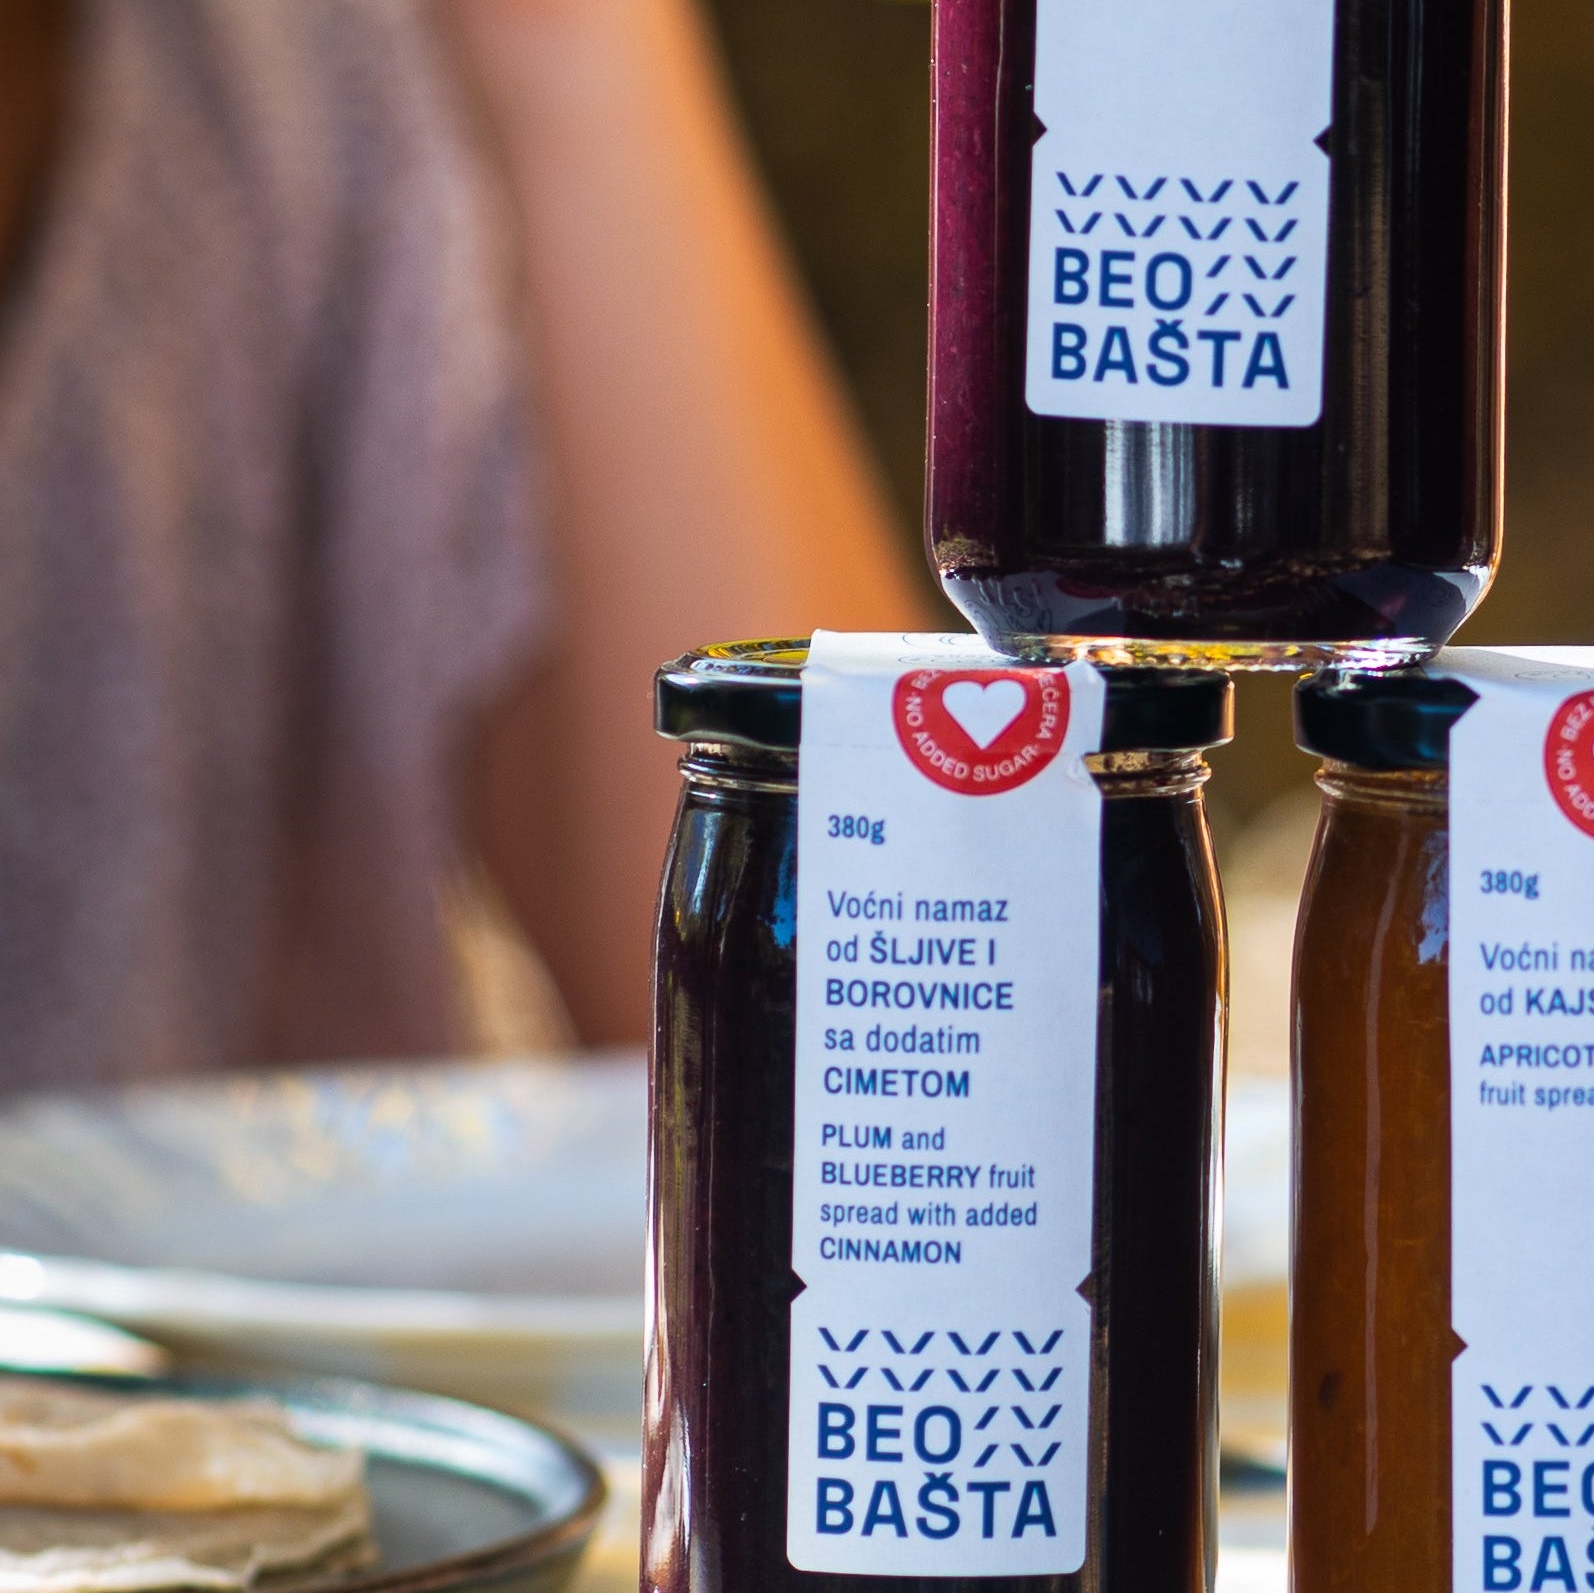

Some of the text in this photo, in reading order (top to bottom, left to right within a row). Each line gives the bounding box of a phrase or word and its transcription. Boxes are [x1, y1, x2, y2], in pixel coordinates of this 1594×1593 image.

[1054, 247, 1192, 311] BEO
[1052, 316, 1289, 389] BAŠTA
[906, 696, 1038, 782] NO ADDED SUGAR
[828, 815, 885, 845] 380g
[1481, 870, 1539, 900] 380g
[828, 890, 1008, 922] Voćni namaz
[827, 931, 995, 966] od ŠLJIVE I
[1480, 943, 1558, 971] Voćni
[826, 979, 1013, 1010] BOROVNICE
[1480, 987, 1513, 1015] od
[825, 1024, 980, 1054] sa dodatim
[824, 1067, 969, 1098] CIMETOM
[1480, 1080, 1525, 1106] fruit
[822, 1124, 945, 1151] PLUM and
[822, 1162, 1035, 1189] BLUEBERRY fruit
[821, 1201, 1037, 1227] spread with added
[820, 1237, 961, 1263] CINNAMON
[818, 1402, 961, 1464] BEO
[817, 1472, 1057, 1540] BAŠTA
